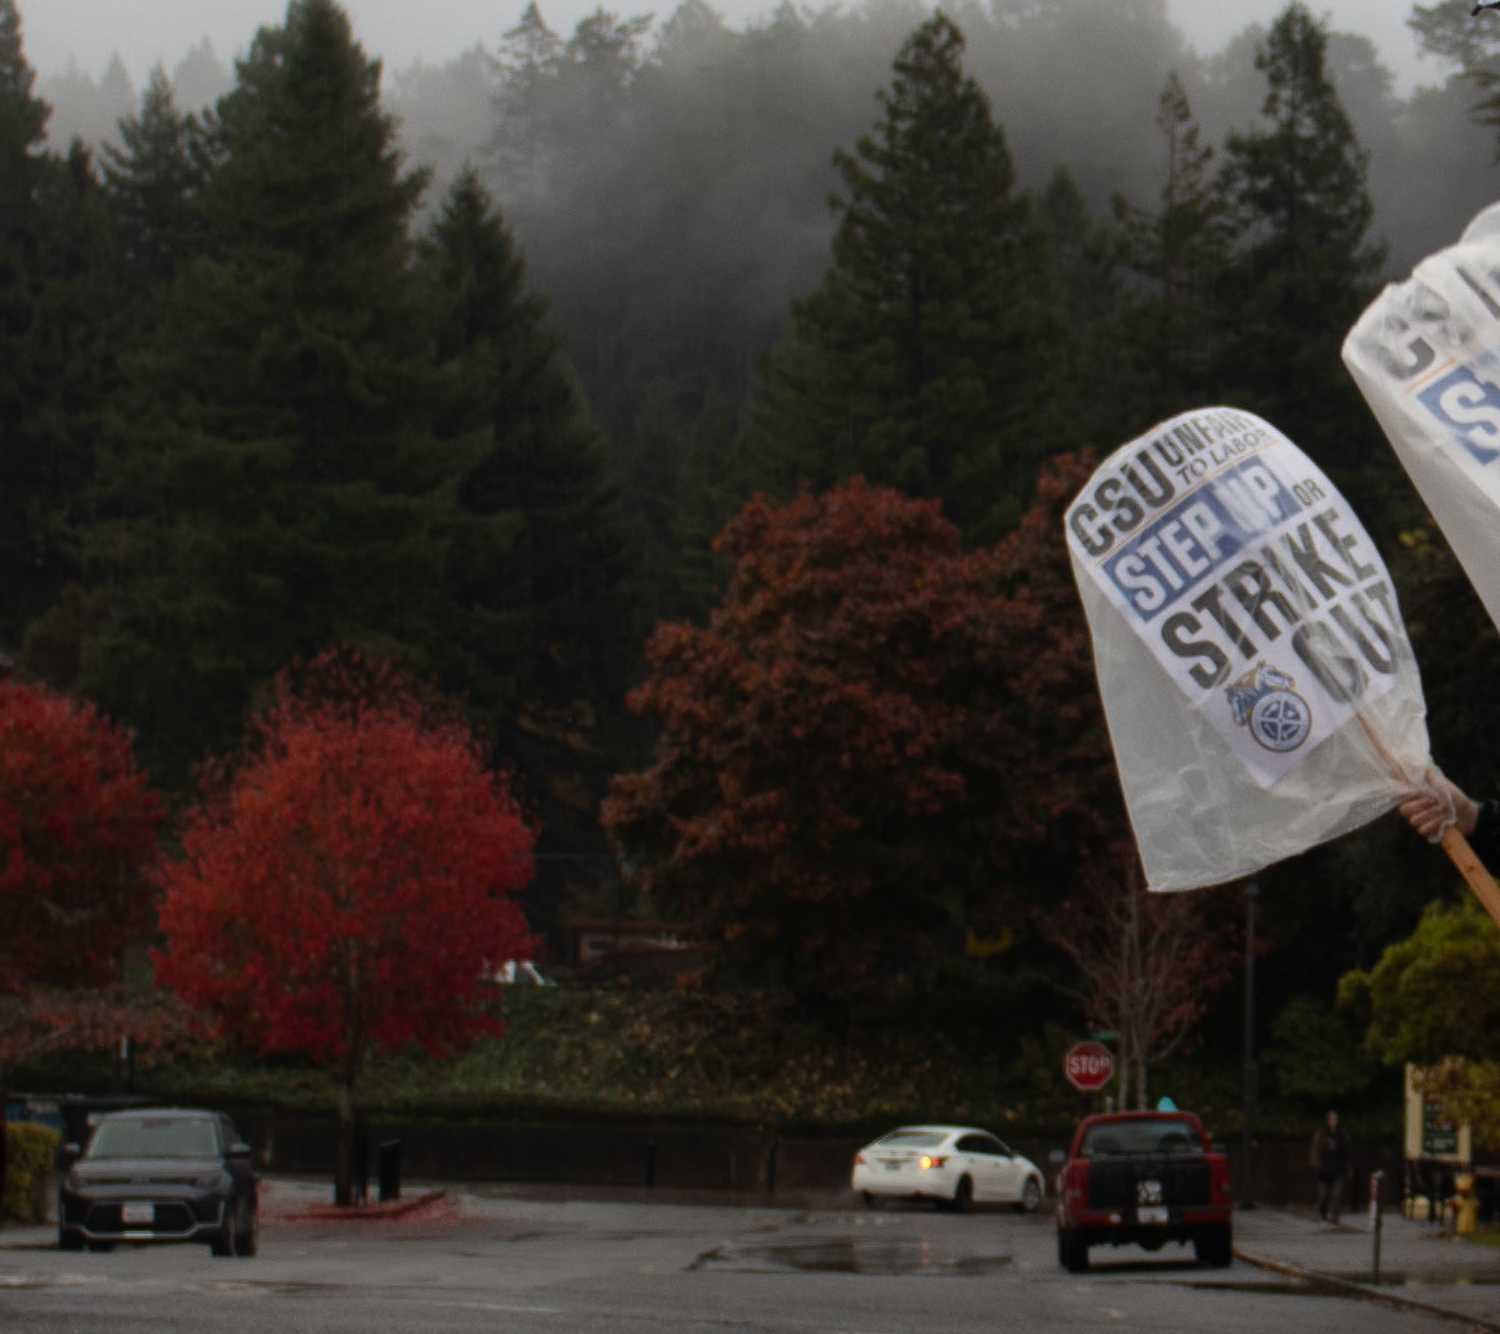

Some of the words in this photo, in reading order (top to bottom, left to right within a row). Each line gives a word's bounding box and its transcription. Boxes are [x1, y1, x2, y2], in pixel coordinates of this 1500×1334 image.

[1070, 450, 1176, 556] CSU
[1176, 457, 1208, 485] TO
[1291, 477, 1327, 513] OR
[1114, 500, 1223, 611] STEP
[1213, 464, 1281, 533] UP
[1160, 507, 1378, 691] STRIKE
[1291, 580, 1402, 704] OUT
[1069, 1055, 1109, 1075] STOP
